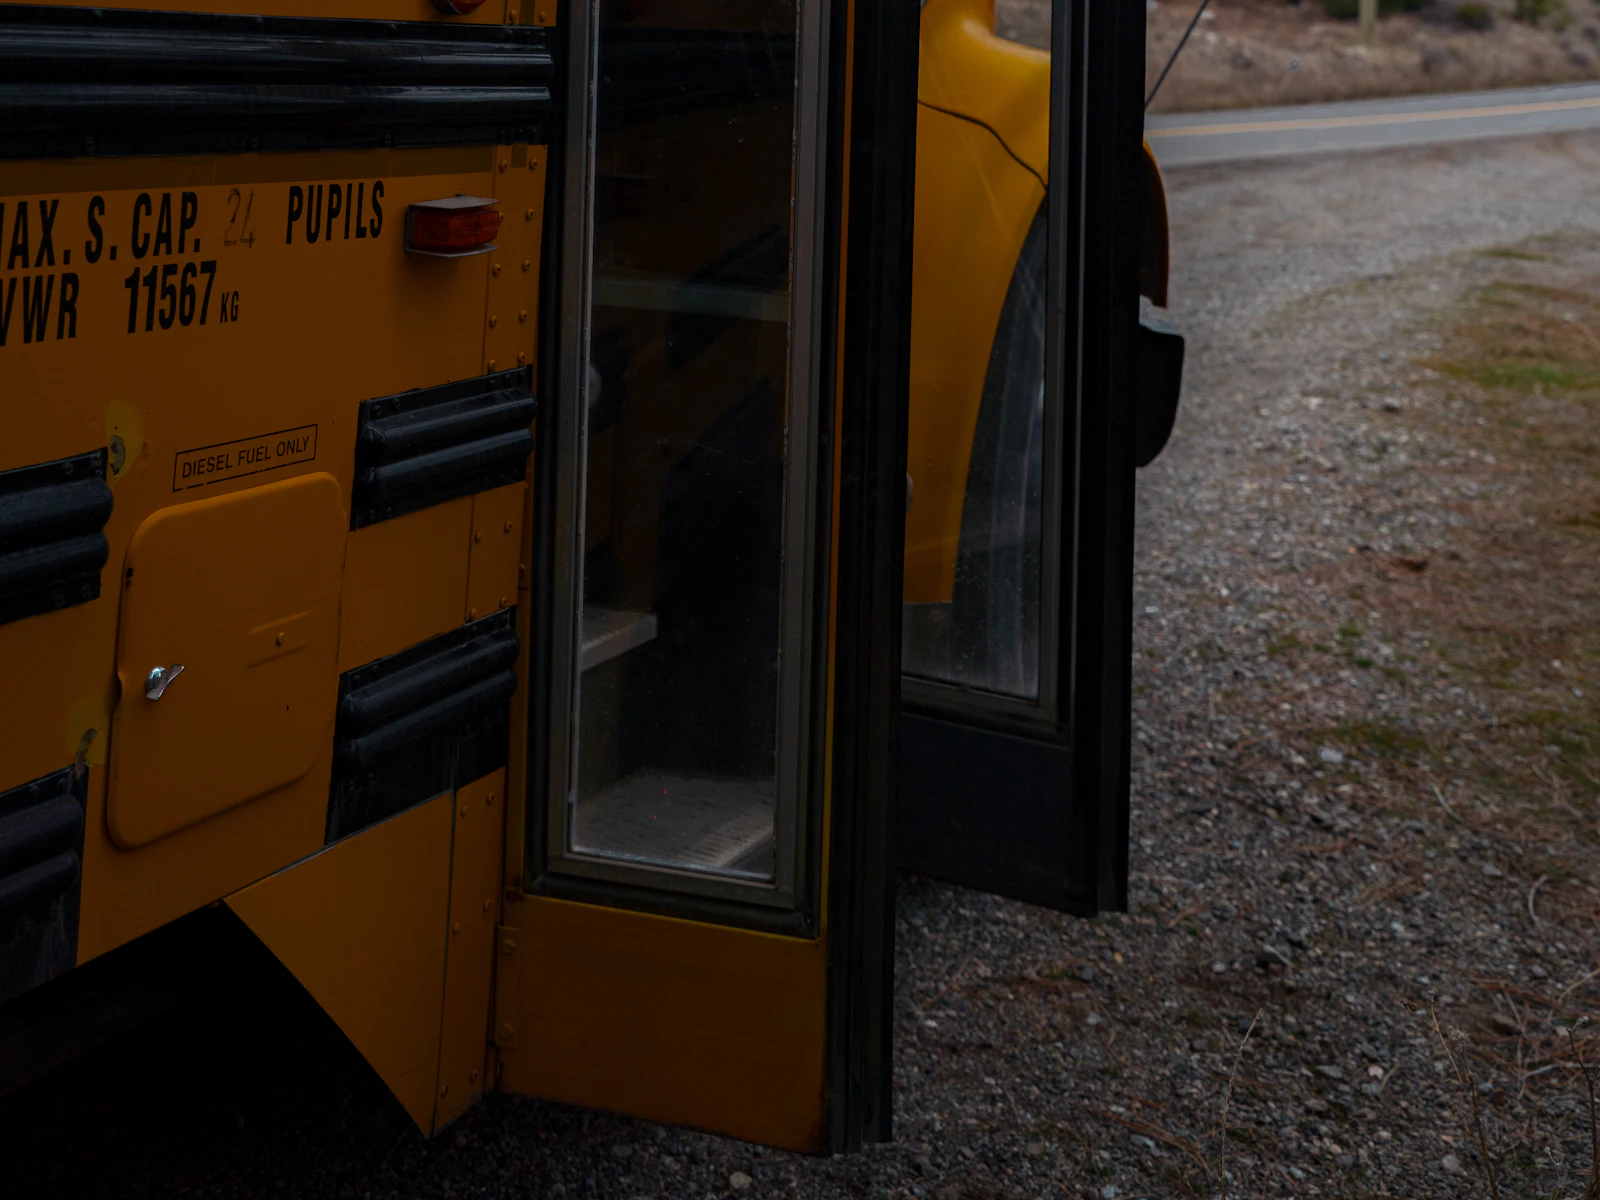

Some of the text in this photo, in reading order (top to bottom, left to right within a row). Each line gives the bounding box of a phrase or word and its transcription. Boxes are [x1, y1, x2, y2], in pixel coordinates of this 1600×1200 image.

[0, 198, 71, 271] AX.
[85, 195, 118, 264] S.
[131, 190, 201, 261] CAP.
[285, 179, 385, 246] PUPILS
[124, 259, 217, 335] 11567
[219, 290, 240, 324] KG
[182, 435, 311, 479] DIESEL FUEL ONLY
